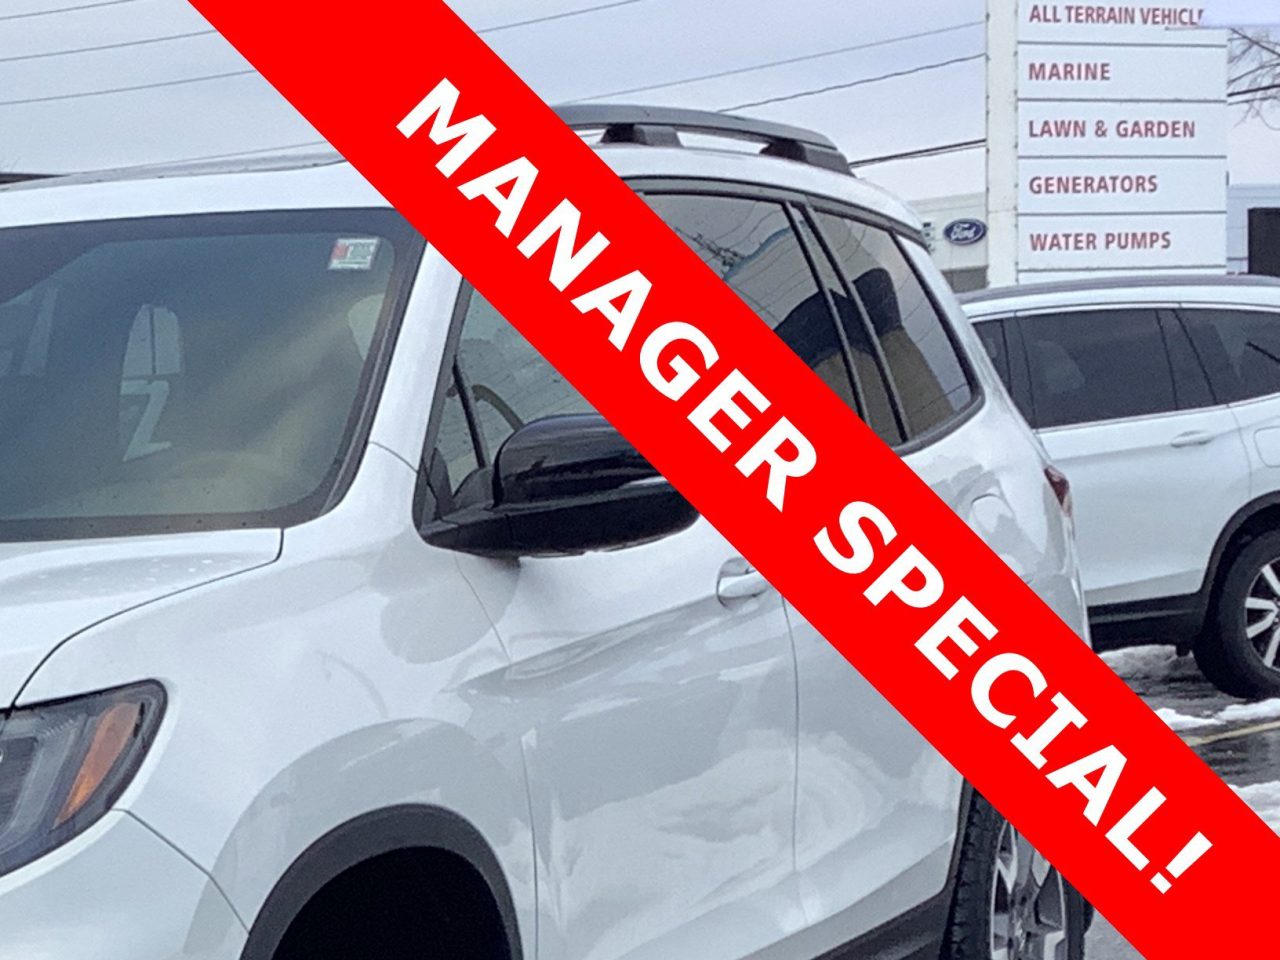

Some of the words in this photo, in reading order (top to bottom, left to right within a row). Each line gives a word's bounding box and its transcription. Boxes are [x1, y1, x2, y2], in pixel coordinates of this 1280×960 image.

[1029, 5, 1061, 24] ALL
[1066, 6, 1135, 25] TERRAIN
[1028, 62, 1111, 81] MARINE
[1028, 120, 1086, 138] LAWN
[1094, 120, 1108, 138] &
[1115, 120, 1195, 138] GARDEN
[1028, 175, 1158, 194] GENERATORS
[1030, 233, 1097, 251] WATER
[1105, 231, 1171, 250] PUMPS
